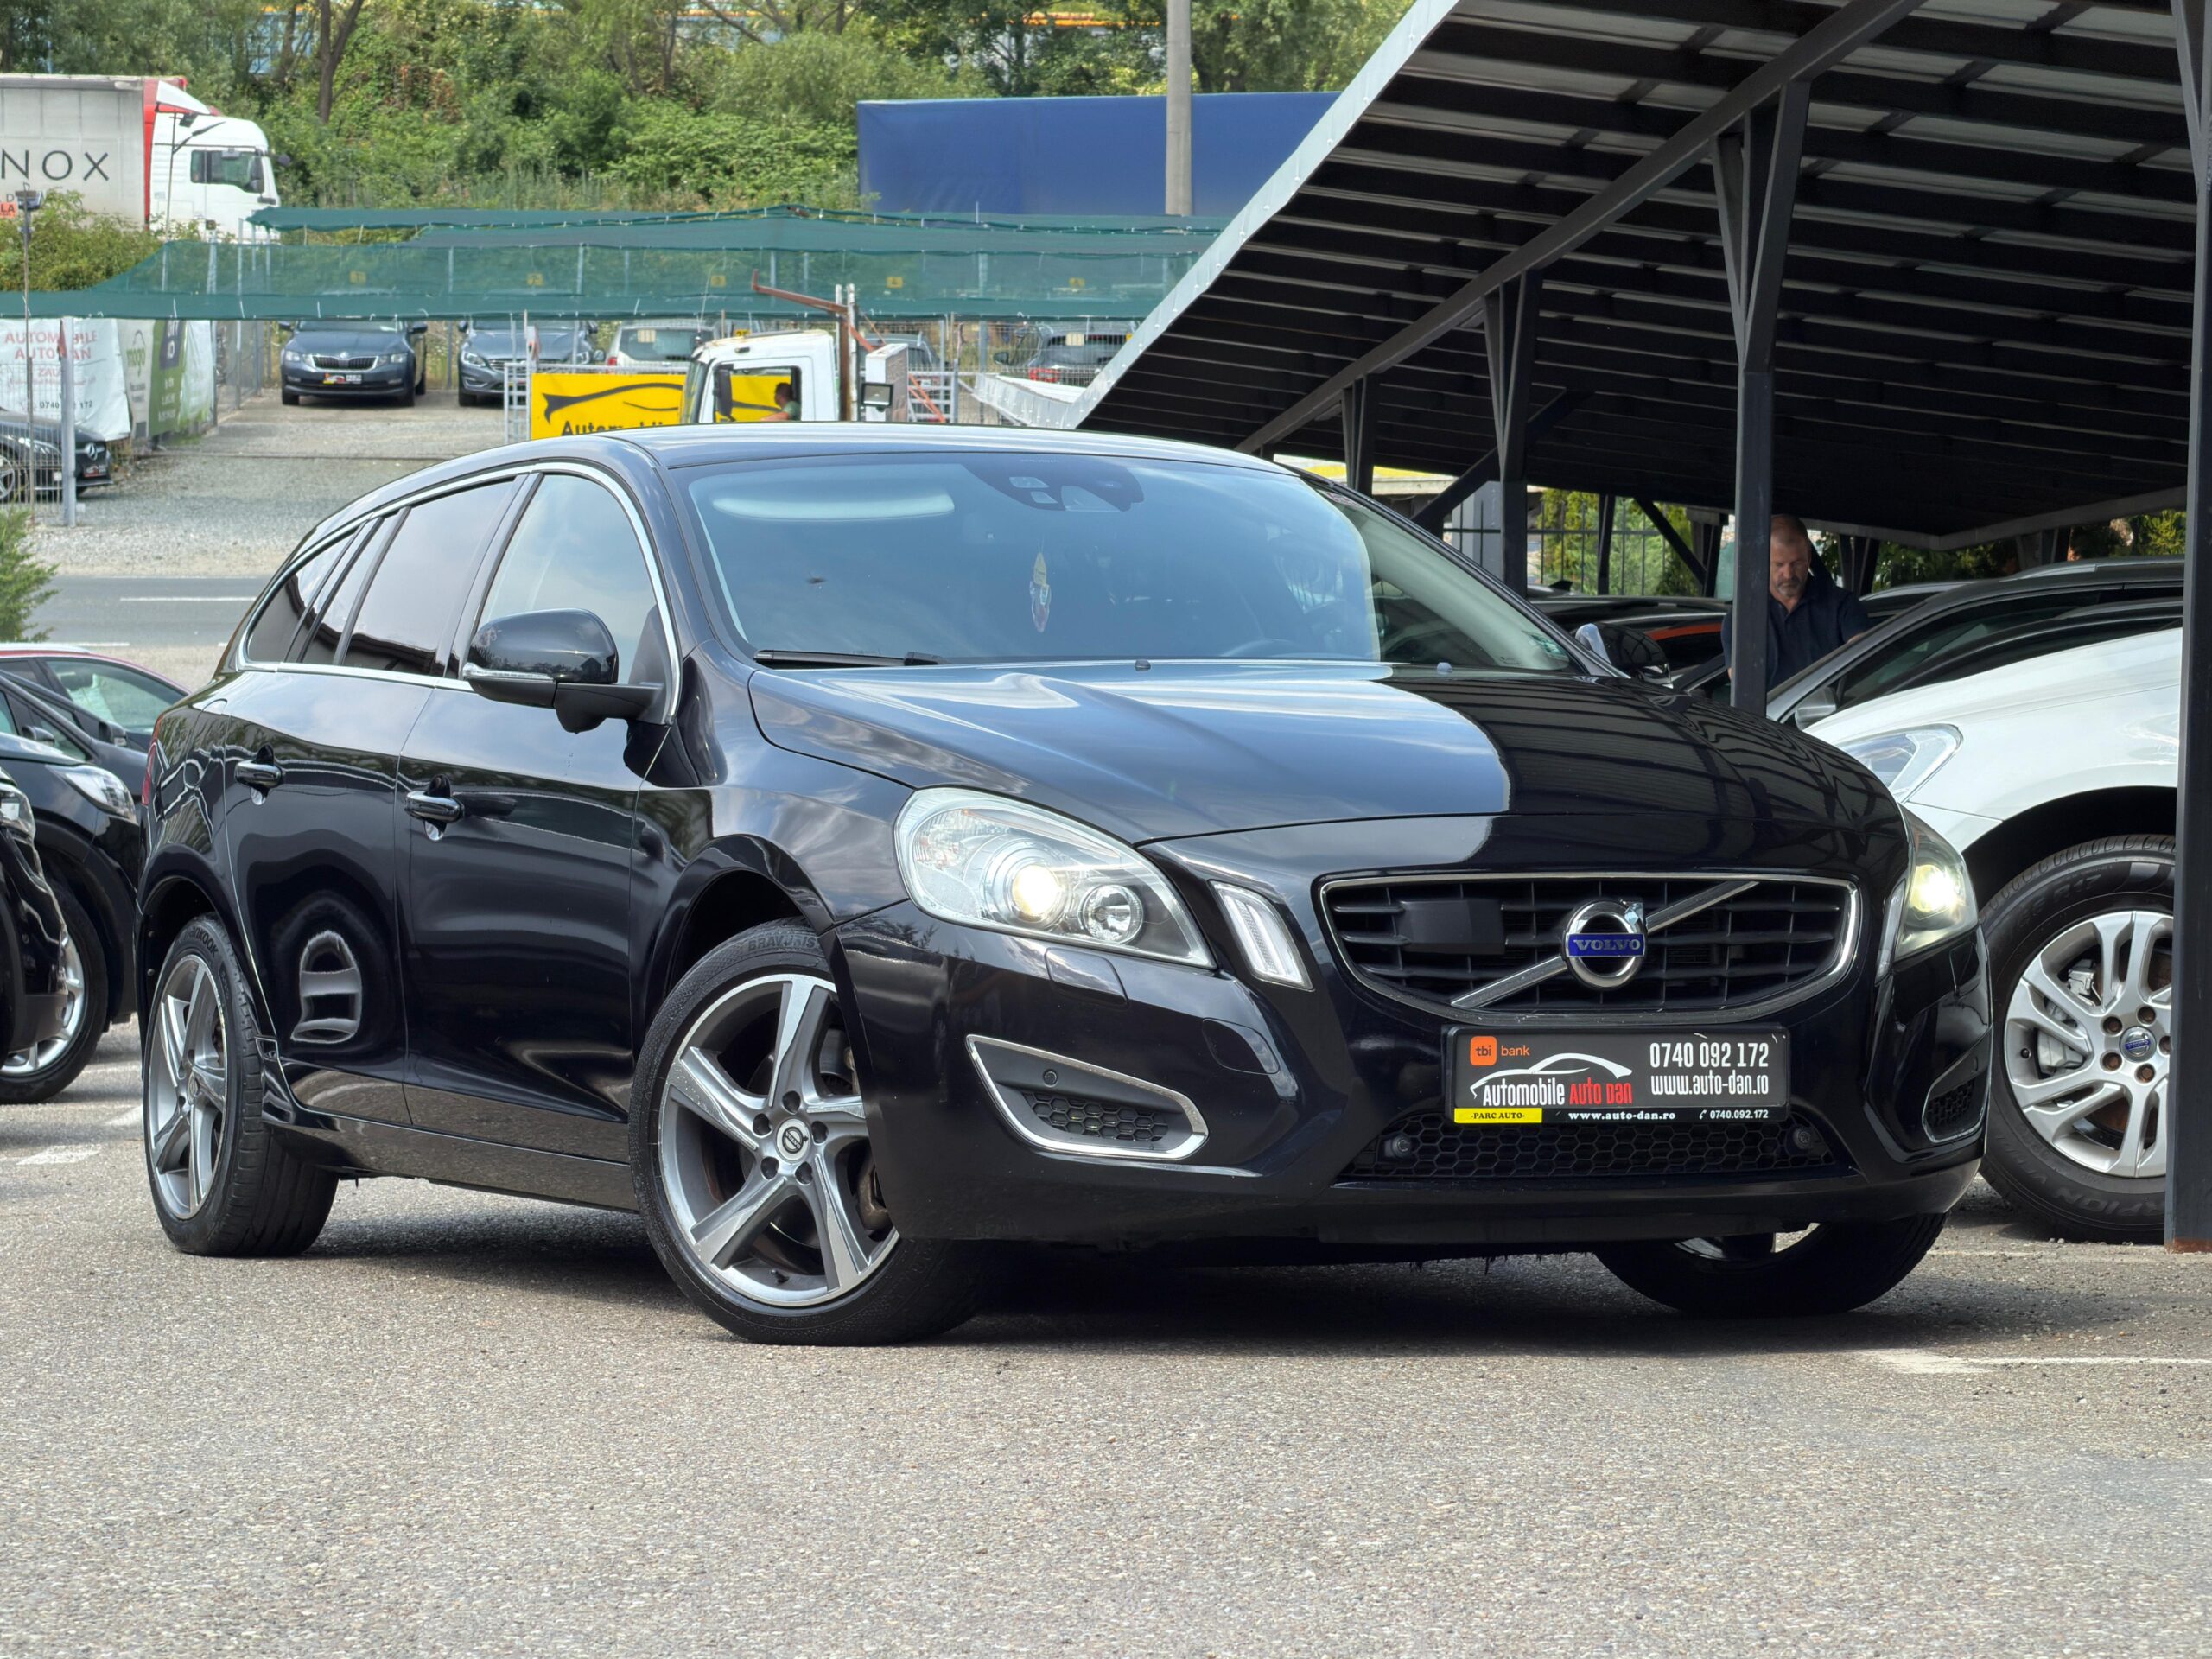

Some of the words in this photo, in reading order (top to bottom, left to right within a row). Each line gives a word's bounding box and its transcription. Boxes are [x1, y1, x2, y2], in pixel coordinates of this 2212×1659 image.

[4, 330, 97, 344] AUTOMBILE
[1573, 938, 1641, 950] VOLVO
[1475, 1046, 1492, 1057] tbi
[1501, 1045, 1530, 1057] bank
[1649, 1041, 1694, 1068] 0740
[1700, 1041, 1732, 1068] 092
[1737, 1041, 1769, 1068] 172
[1650, 1069, 1769, 1096] www.auto-dan.ro
[1483, 1077, 1566, 1107] Automobile
[1568, 1110, 1676, 1121] www.auto-dan.ro
[1709, 1109, 1769, 1120] 0740.092.172
